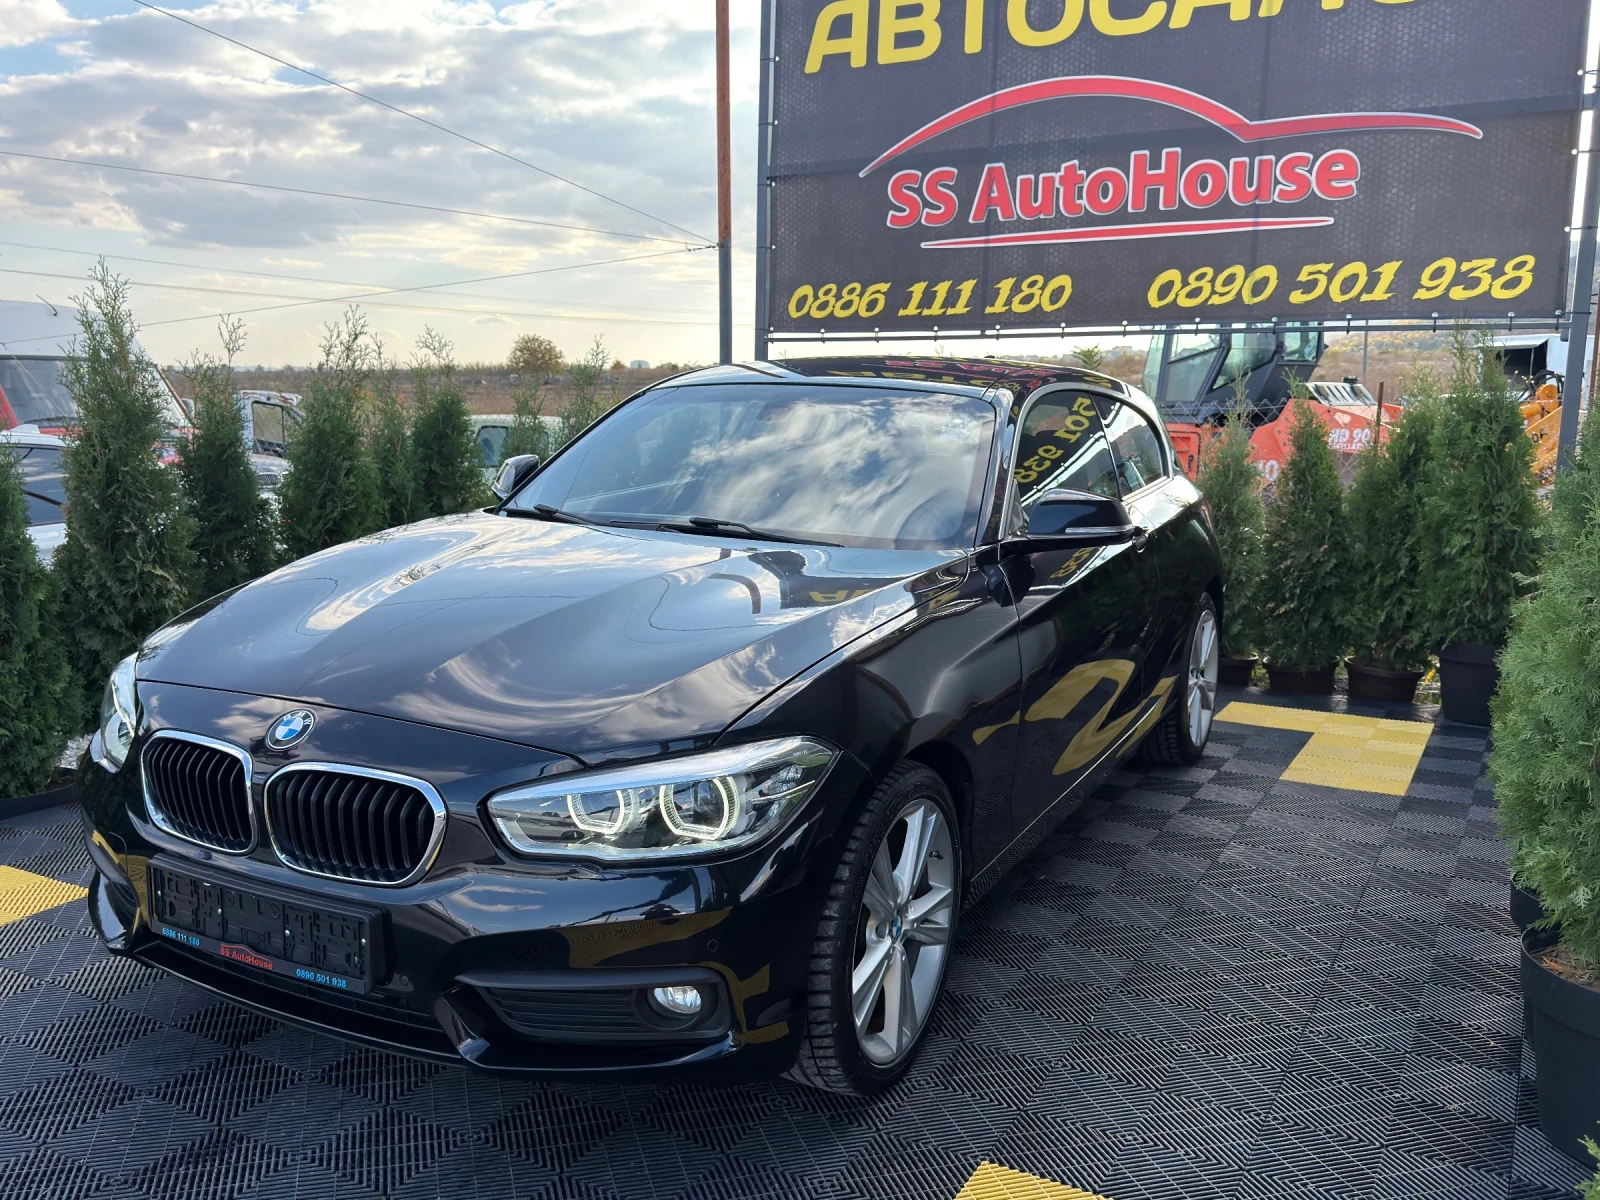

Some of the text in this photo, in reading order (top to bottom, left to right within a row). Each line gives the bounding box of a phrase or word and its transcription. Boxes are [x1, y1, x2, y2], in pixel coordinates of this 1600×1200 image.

[887, 147, 1360, 228] SS AutoHouse
[788, 274, 1073, 319] 0886 111 180
[1147, 254, 1536, 308] 0890 501 938
[177, 932, 188, 942] 111
[220, 946, 273, 970] SS AutoHouse
[296, 968, 347, 988] 0890 501 938
